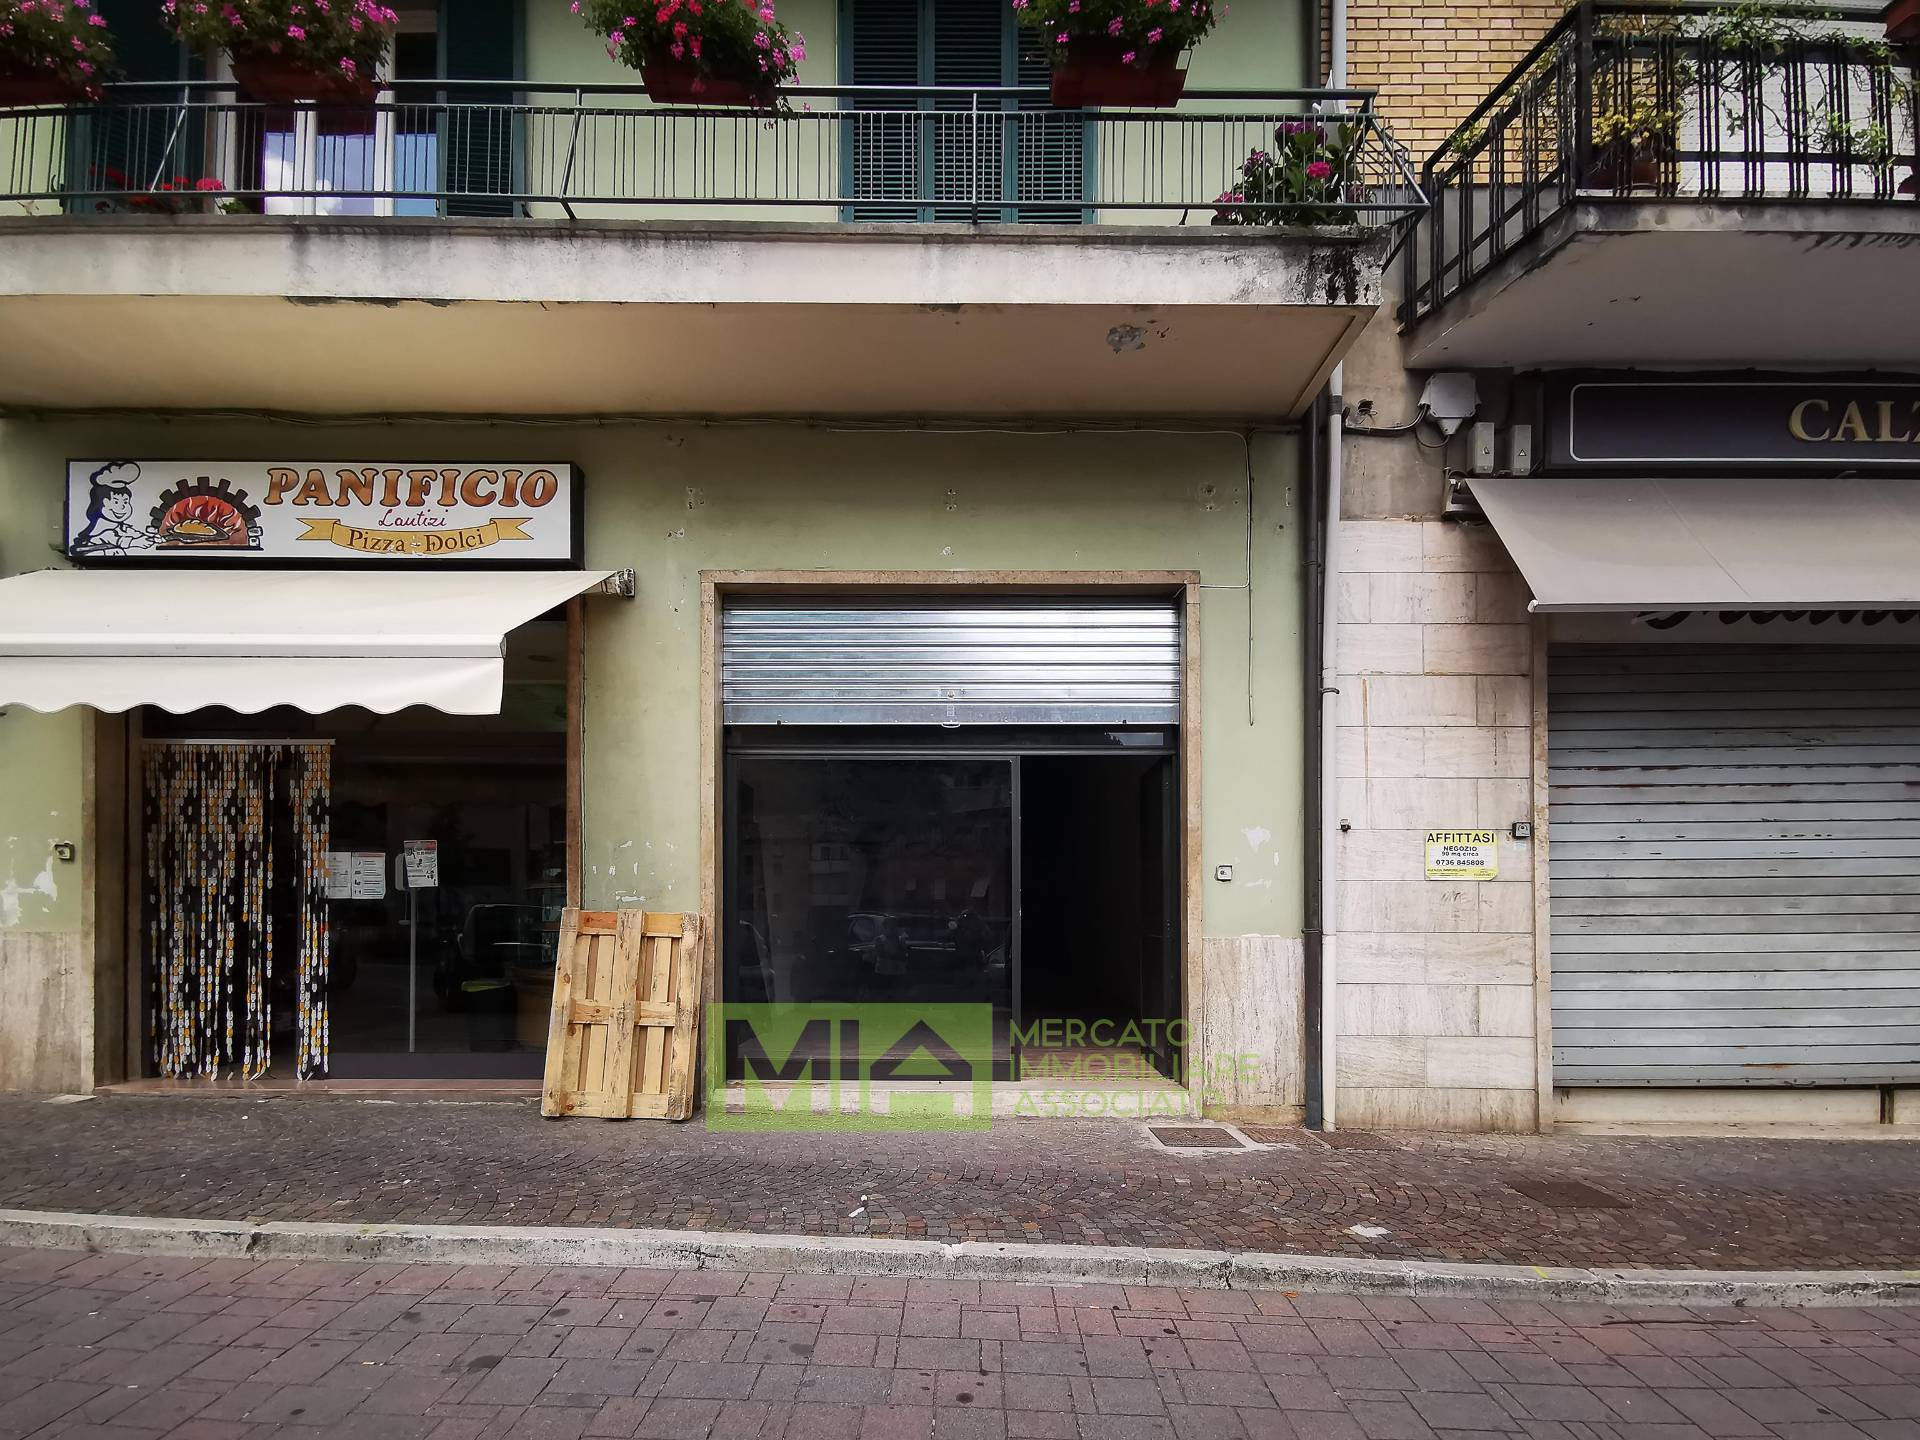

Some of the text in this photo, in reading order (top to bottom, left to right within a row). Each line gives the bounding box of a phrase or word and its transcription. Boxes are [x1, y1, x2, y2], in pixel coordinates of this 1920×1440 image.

[263, 467, 558, 507] PANIFICIO
[378, 508, 450, 527] Lautizi
[349, 528, 406, 552] Pizza
[425, 528, 485, 551] Dolci
[1427, 833, 1495, 843] AFFITTASI
